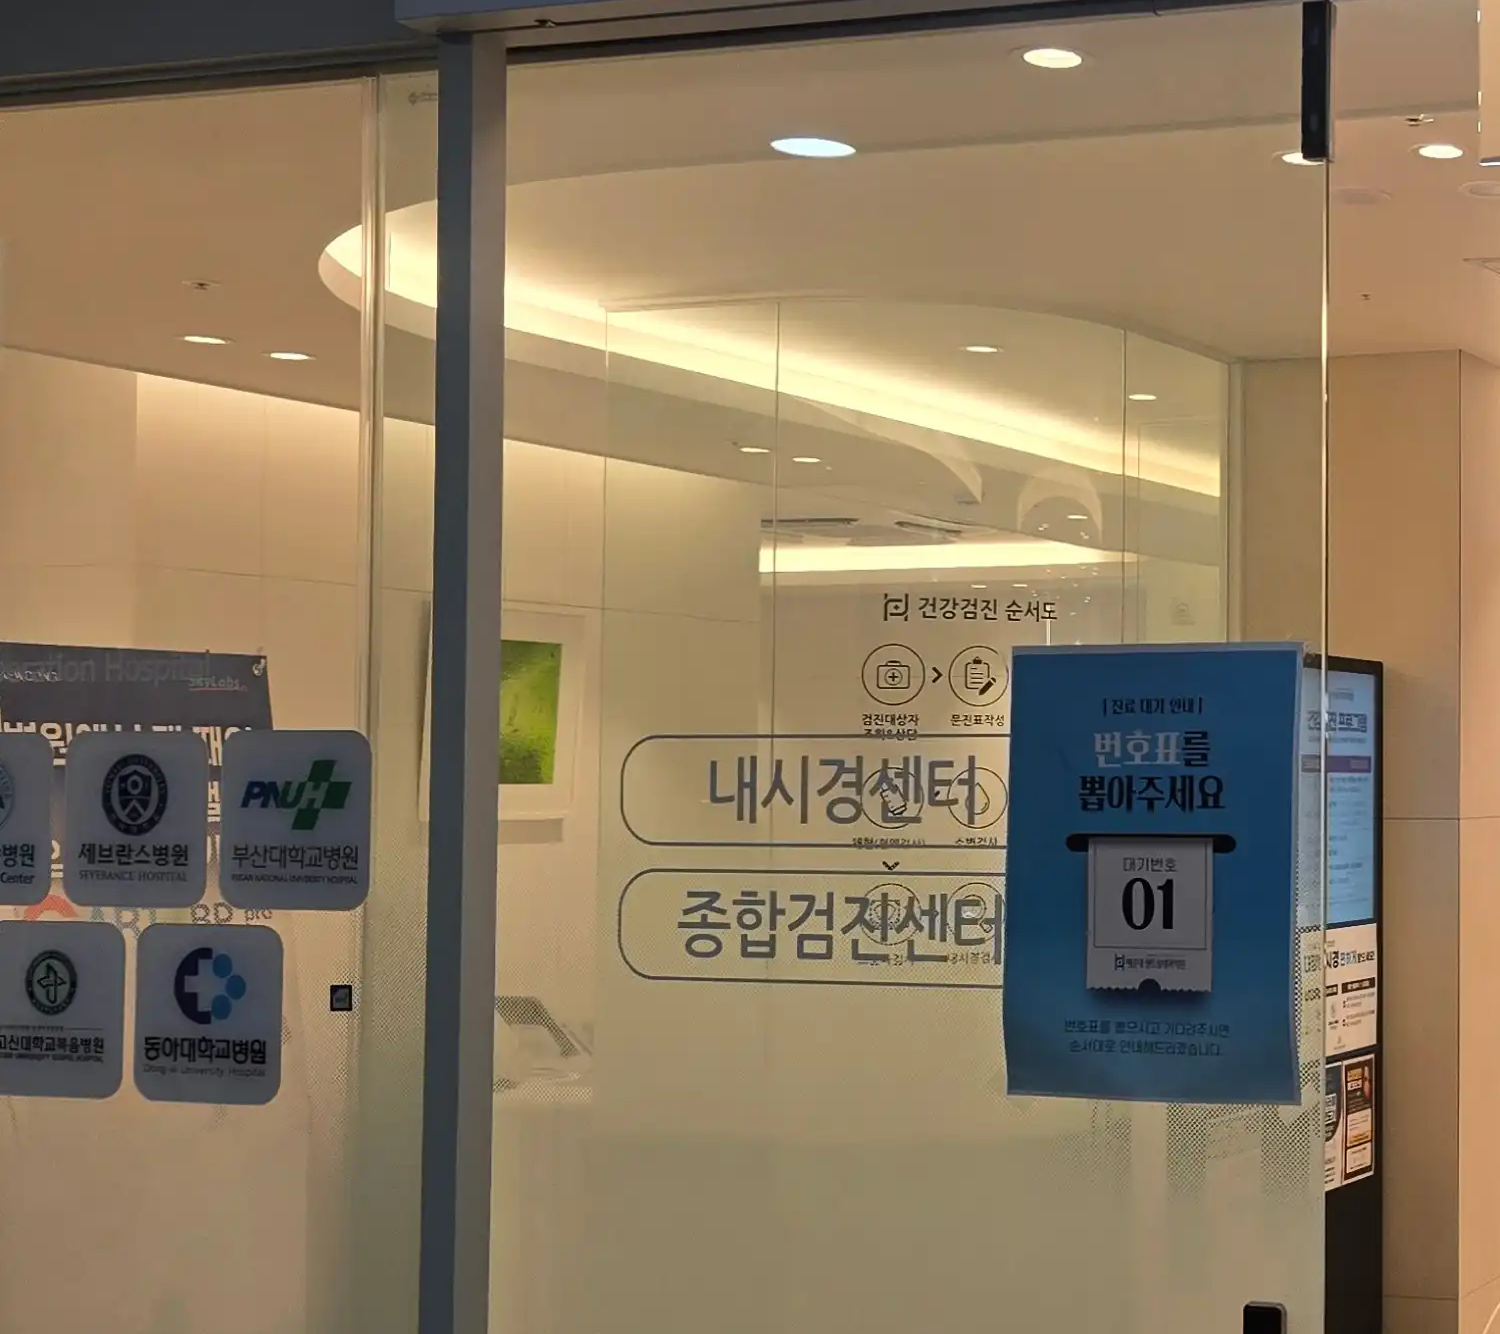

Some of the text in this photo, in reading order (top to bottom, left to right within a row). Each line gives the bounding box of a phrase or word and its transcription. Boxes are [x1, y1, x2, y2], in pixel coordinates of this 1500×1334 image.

[918, 596, 1058, 622] 건강검진 순서도
[1111, 697, 1195, 715] 진료 대기 안내
[861, 714, 1005, 727] 검진대상자 문진표작성
[1093, 729, 1211, 768] 번호표를
[241, 780, 331, 810] PNUH
[709, 755, 976, 826] 내시경센터
[1078, 774, 1226, 813] 뽑아주세요
[0, 842, 36, 868] 병원
[78, 842, 189, 867] 세브란스병원
[231, 844, 359, 870] 부산대학교병원
[1122, 856, 1178, 873] 대기번호
[0, 870, 36, 885] Center
[79, 870, 188, 883] SEVERANCE HOSPITAL
[1121, 877, 1174, 930] 01
[677, 889, 1003, 966] 종합검진센터
[1064, 1019, 1230, 1038] 번호표를 뽑으시고 기다려주시면
[144, 1036, 267, 1065] 동아대학교병원
[1069, 1039, 1116, 1054] 순서대로
